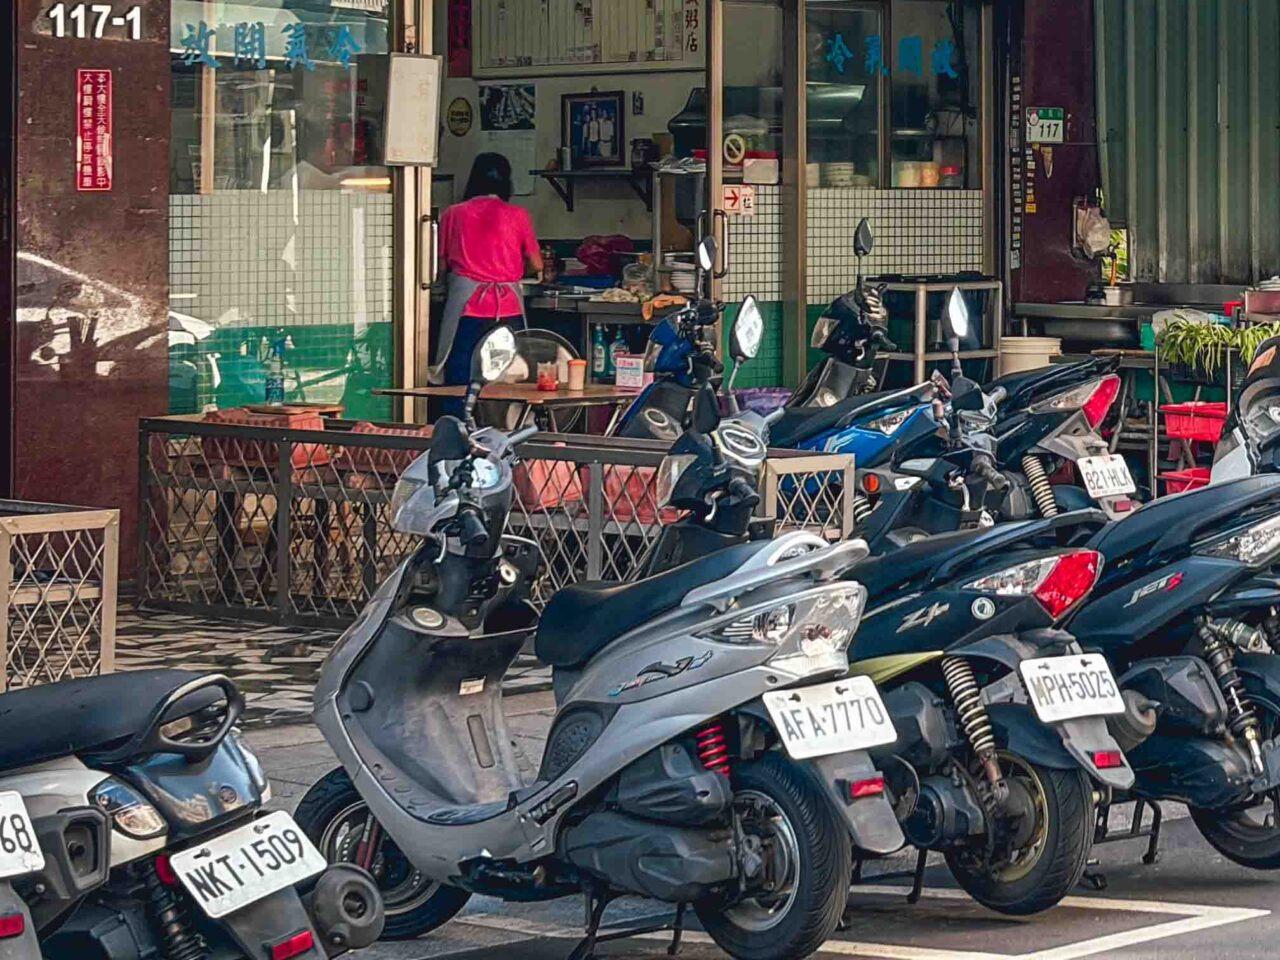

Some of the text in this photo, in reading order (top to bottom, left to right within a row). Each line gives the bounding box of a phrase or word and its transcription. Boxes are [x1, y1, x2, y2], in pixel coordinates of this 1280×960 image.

[48, 3, 141, 40] 117-1
[1039, 122, 1060, 138] 117
[1029, 669, 1117, 707] MPH-5025
[779, 696, 886, 742] AFA-7770
[185, 828, 305, 903] NKT-1509
